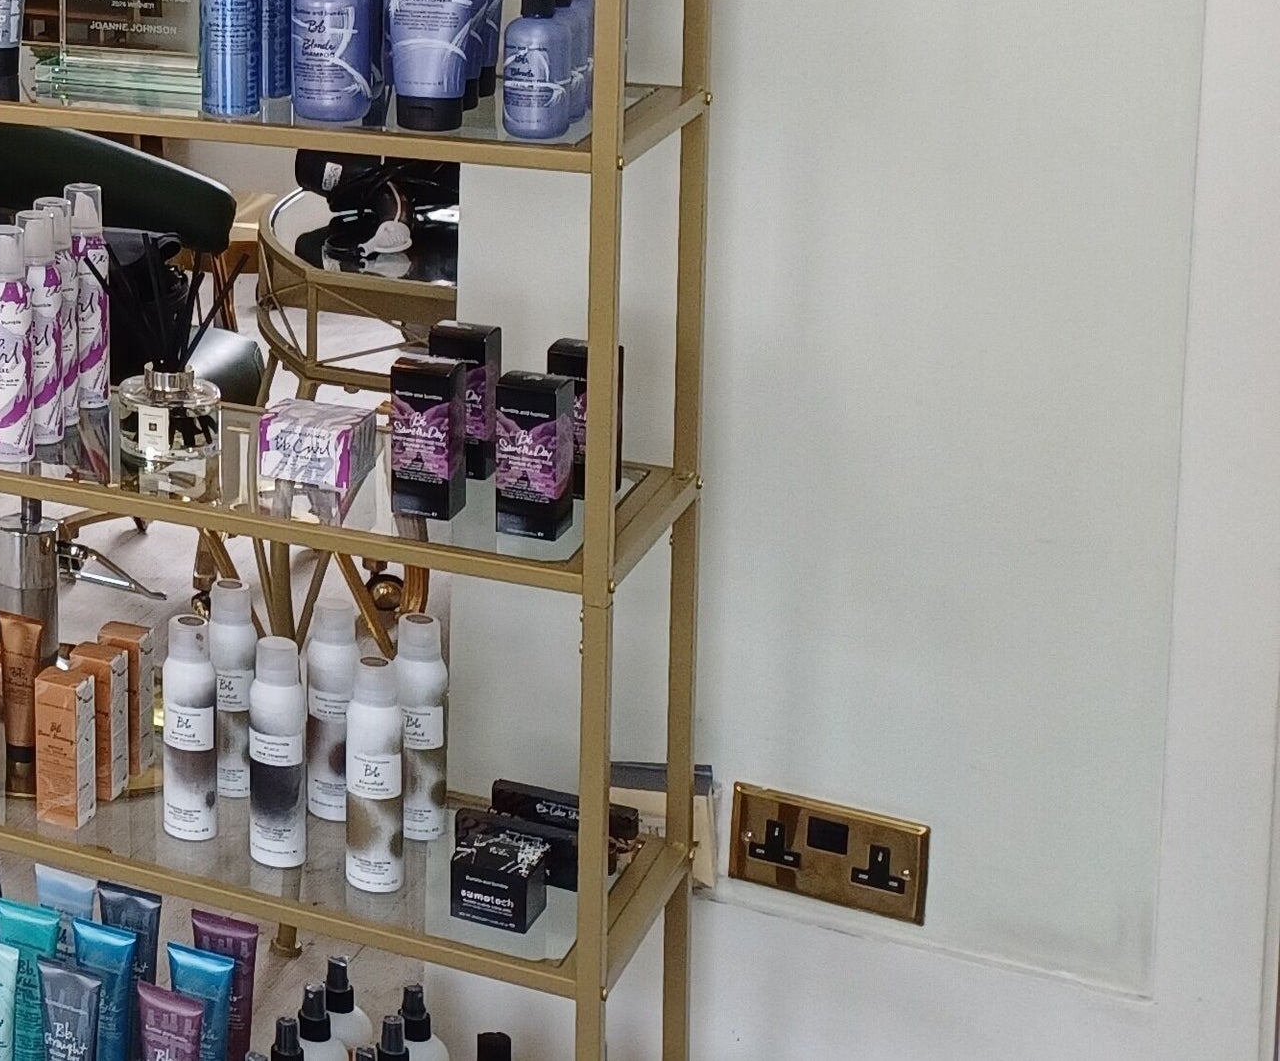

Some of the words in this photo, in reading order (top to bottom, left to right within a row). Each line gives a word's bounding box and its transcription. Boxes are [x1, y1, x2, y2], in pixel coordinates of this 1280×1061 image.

[89, 20, 129, 32] JOANNE
[130, 23, 177, 35] JOHNSON
[460, 889, 515, 909] sumotech
